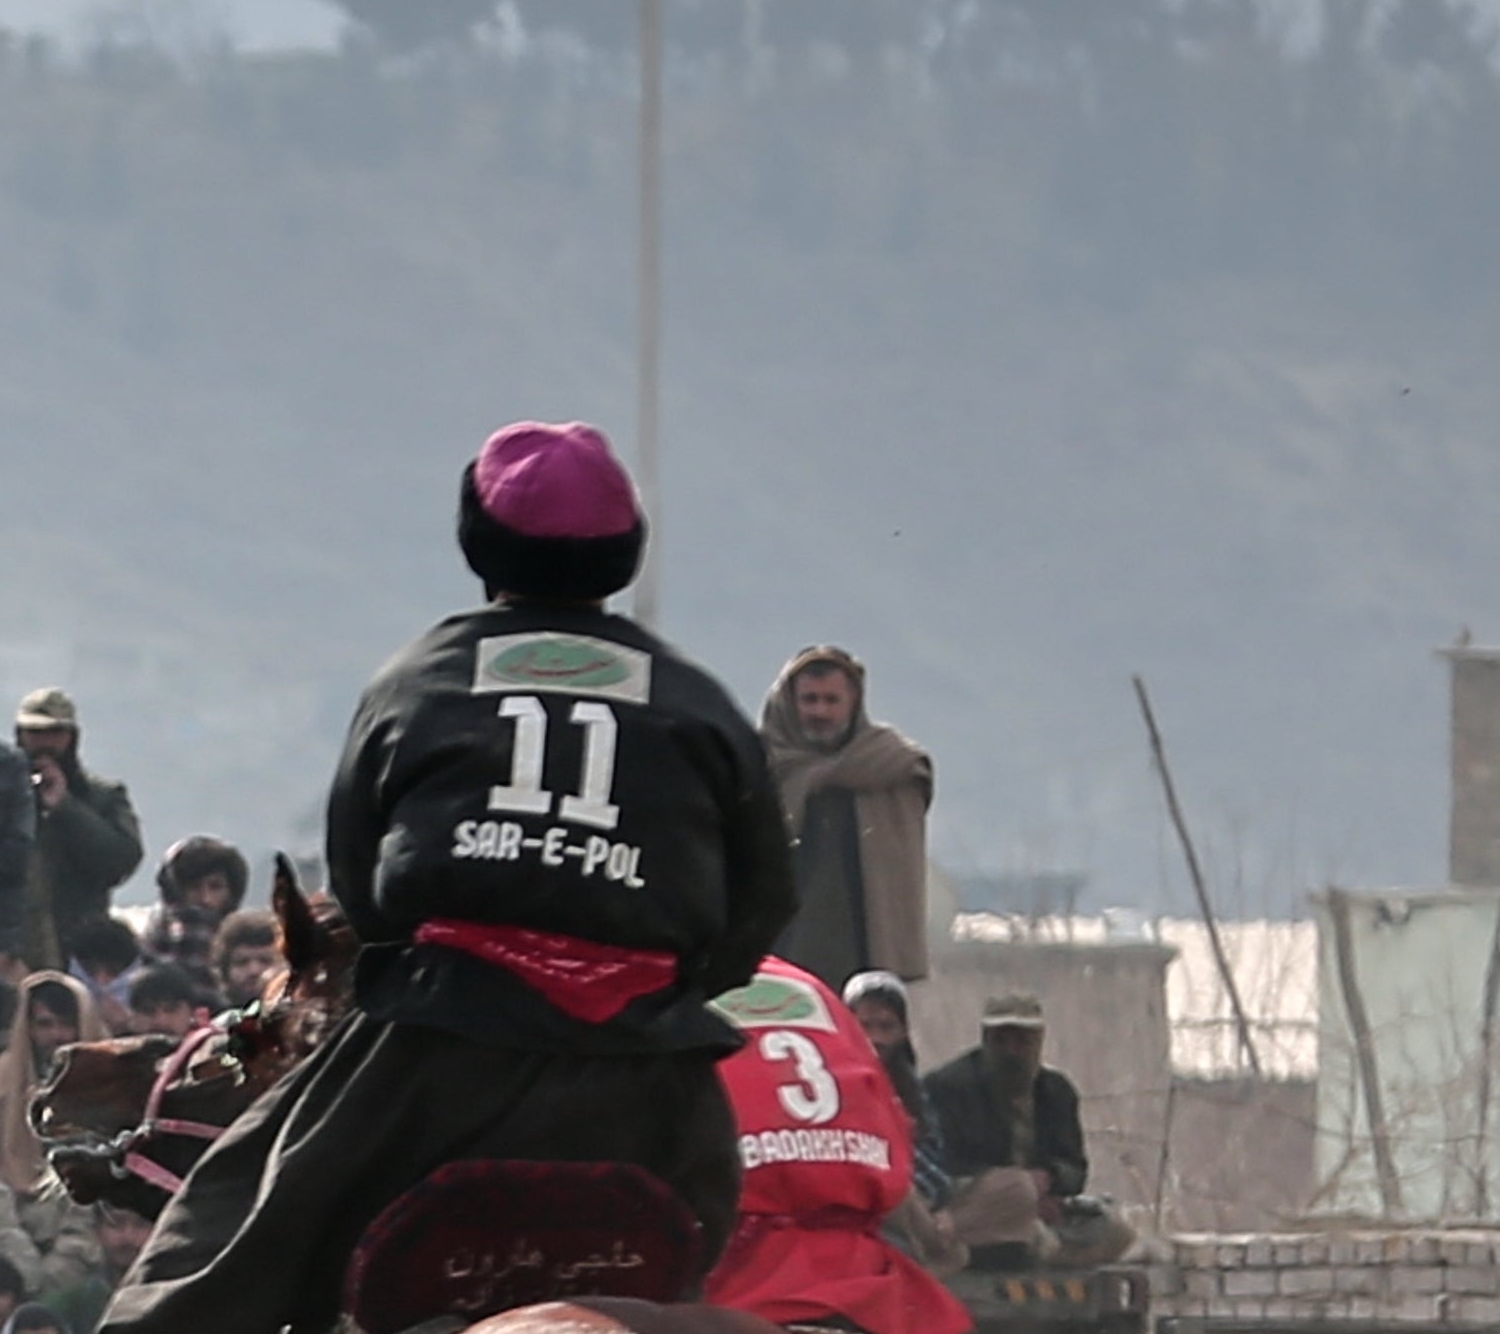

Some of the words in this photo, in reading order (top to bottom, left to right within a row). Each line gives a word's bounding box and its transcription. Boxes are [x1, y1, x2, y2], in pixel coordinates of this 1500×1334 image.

[487, 696, 620, 829] 11
[452, 820, 645, 888] SAR-E-POL
[759, 1030, 840, 1124] 3
